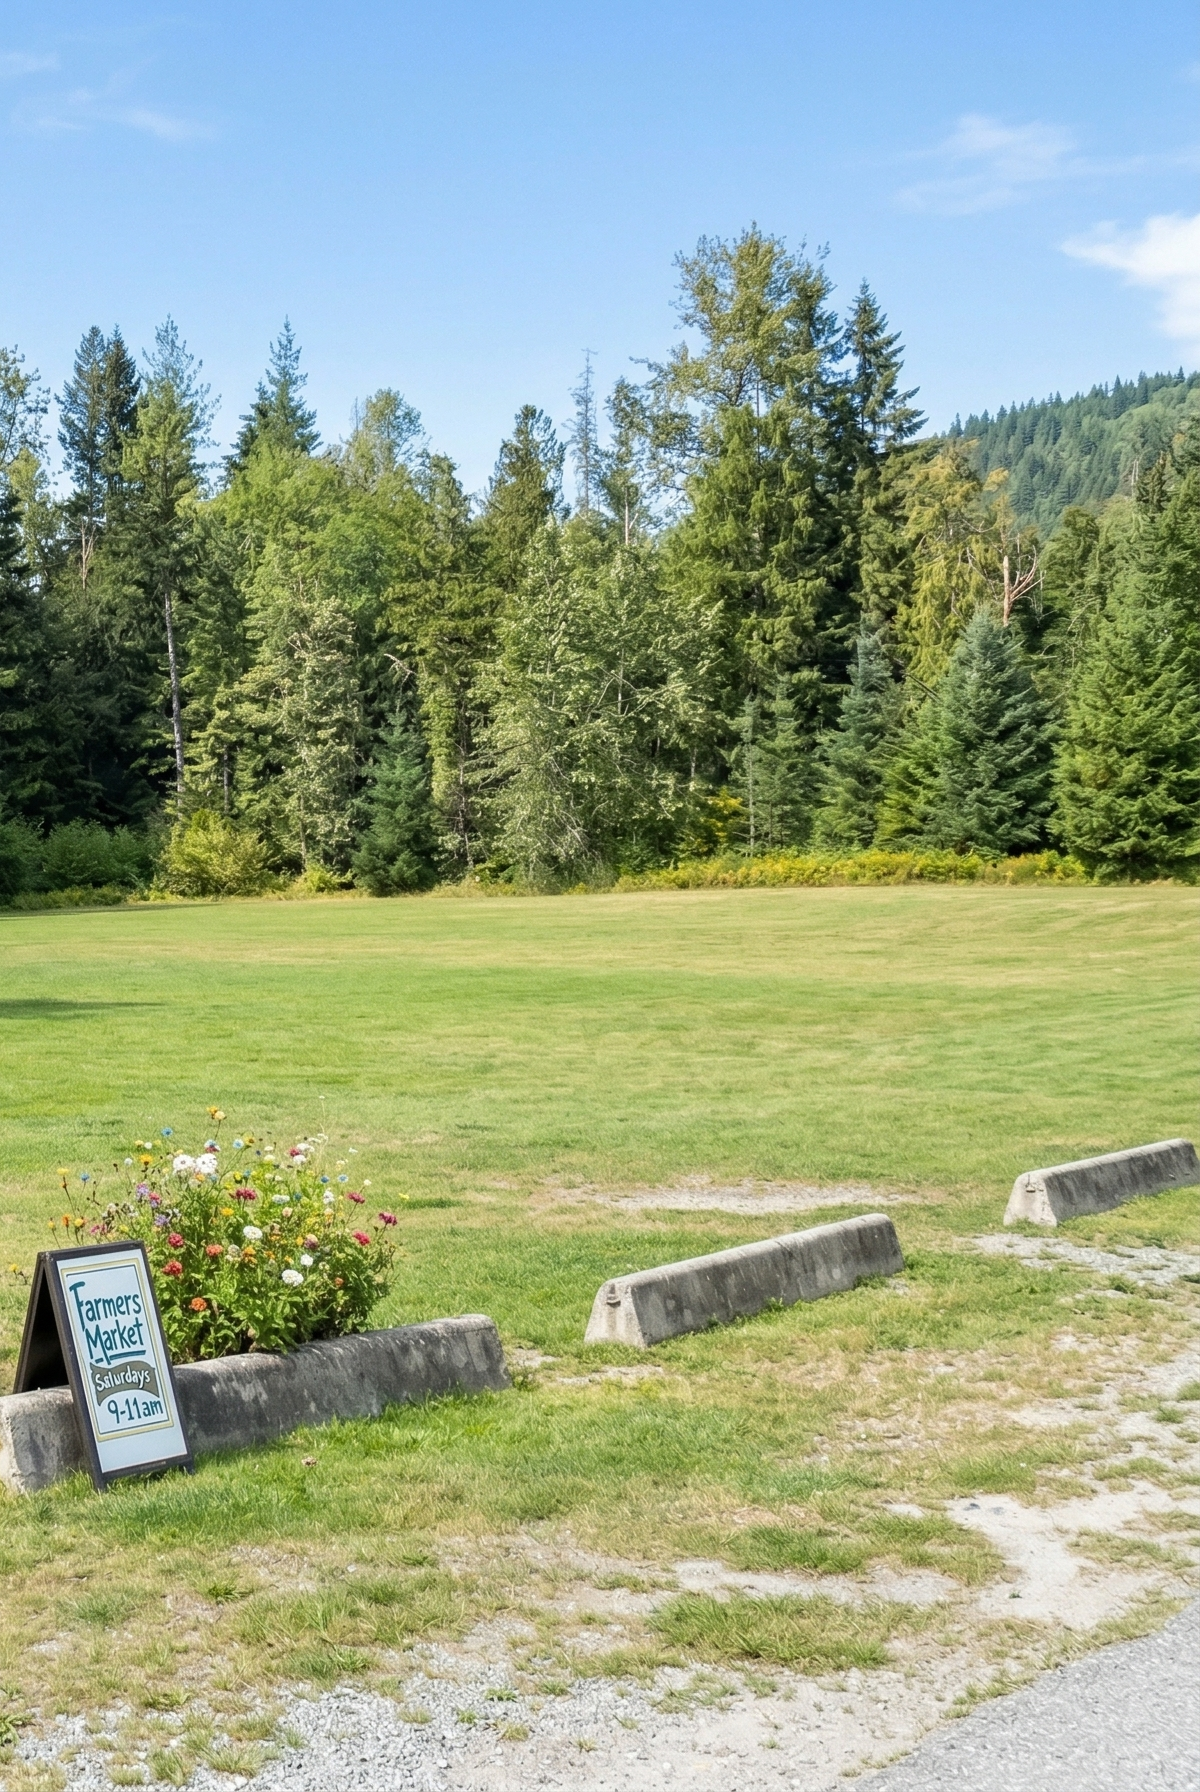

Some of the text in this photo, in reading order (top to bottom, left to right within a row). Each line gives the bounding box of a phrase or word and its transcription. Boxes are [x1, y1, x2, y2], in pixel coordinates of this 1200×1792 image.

[69, 1281, 142, 1332] Farmers
[85, 1317, 144, 1366] Market
[95, 1365, 151, 1391] Saturdays
[107, 1397, 163, 1424] 9-11am
